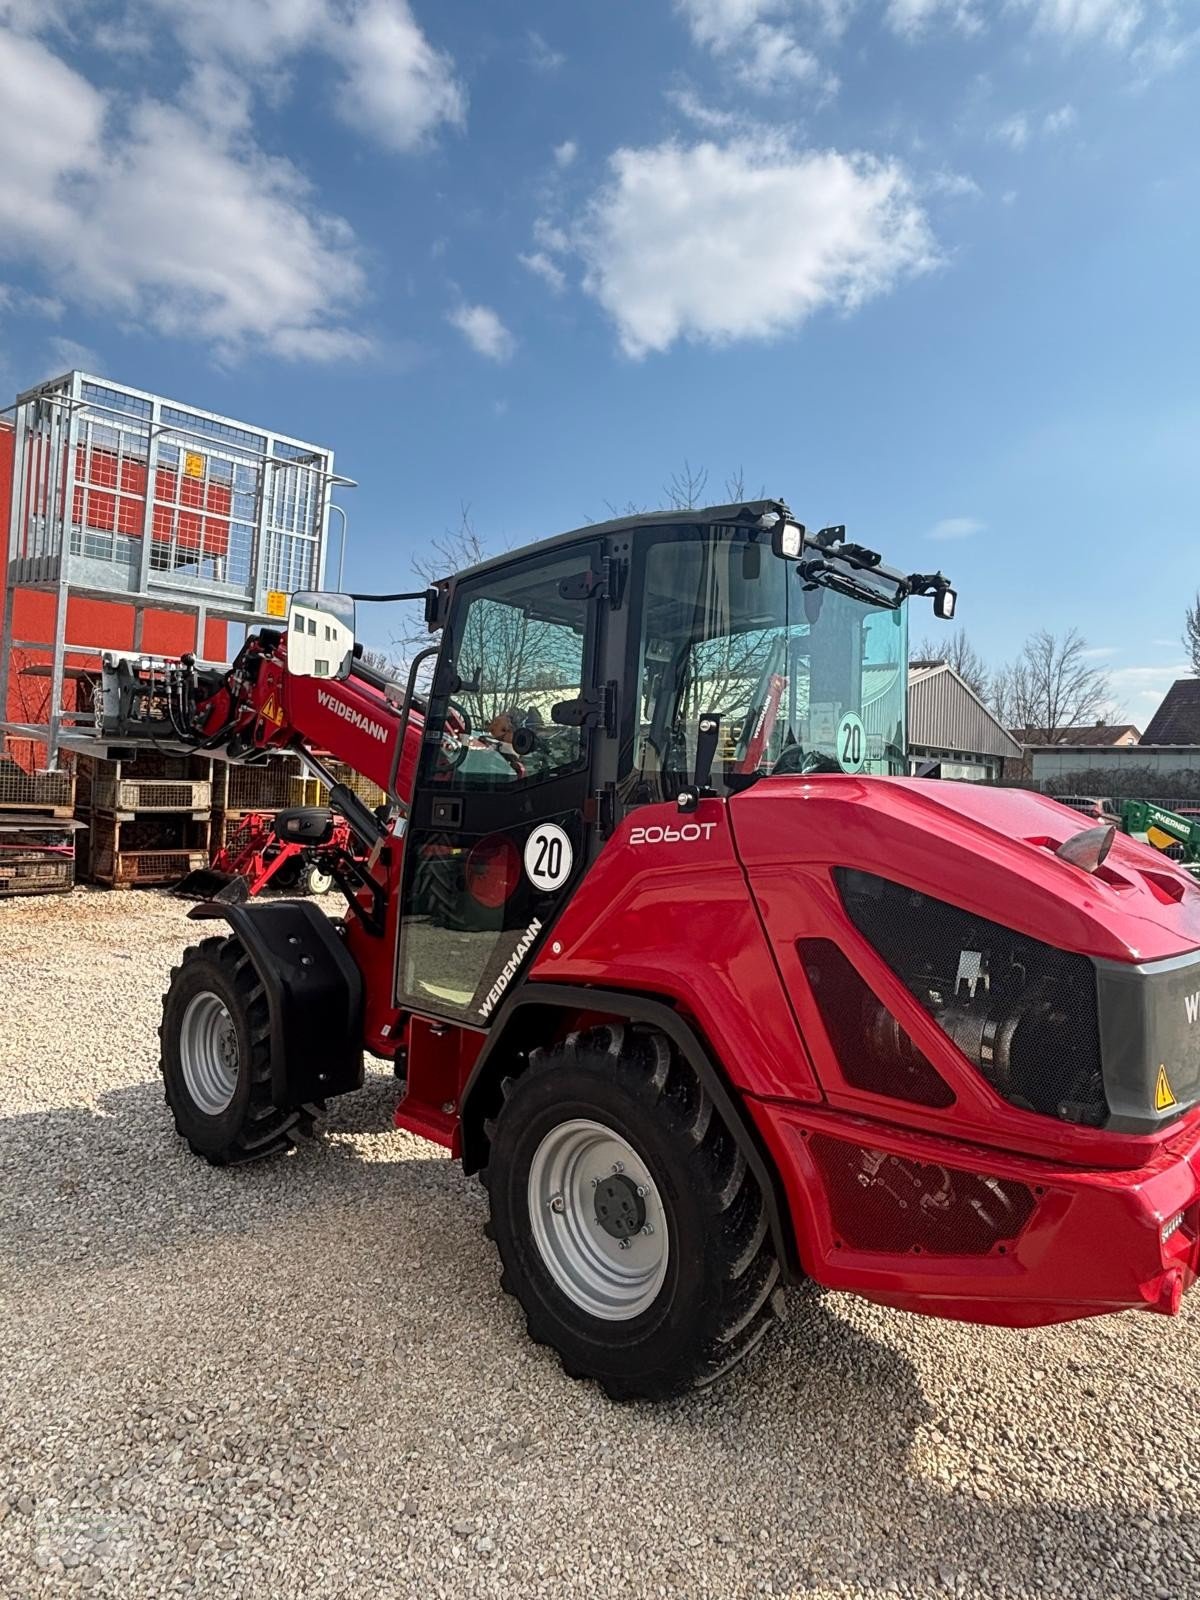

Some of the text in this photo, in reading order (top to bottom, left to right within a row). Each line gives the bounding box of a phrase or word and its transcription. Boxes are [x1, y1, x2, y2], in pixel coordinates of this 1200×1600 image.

[317, 688, 388, 743] WEIDEMANN
[842, 722, 861, 764] 20
[629, 822, 717, 845] 2060T
[1160, 814, 1190, 834] KERNER
[533, 835, 563, 879] 20
[478, 916, 543, 1018] WEIDEMANN
